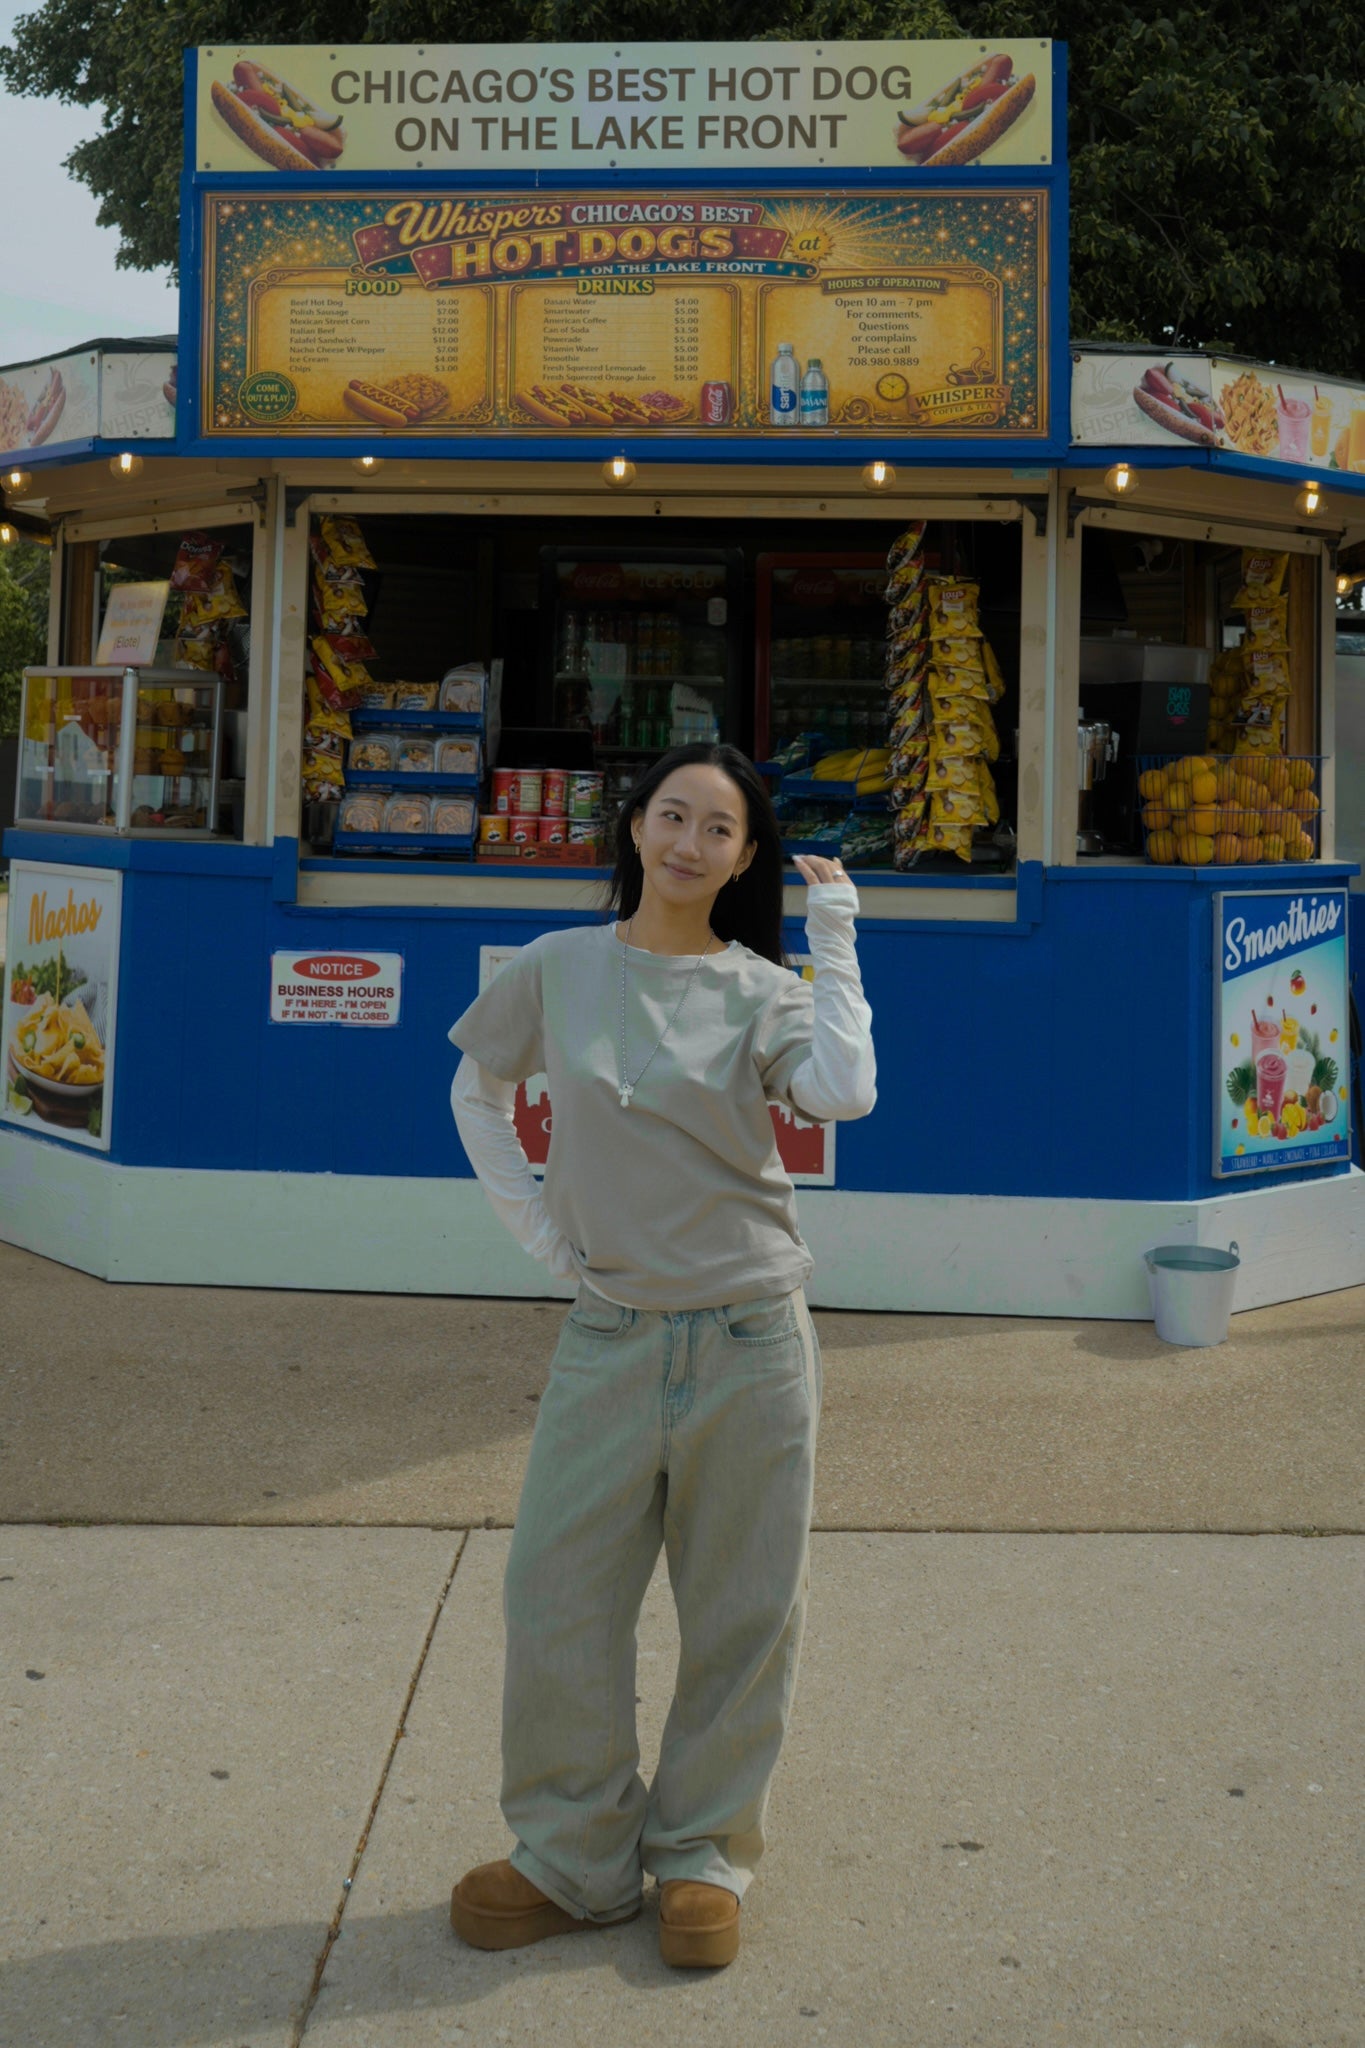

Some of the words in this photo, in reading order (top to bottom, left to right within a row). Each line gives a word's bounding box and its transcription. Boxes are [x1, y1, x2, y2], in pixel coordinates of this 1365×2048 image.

[331, 67, 575, 104] CHICAGO'S
[588, 68, 695, 102] BEST
[708, 67, 800, 101] HOT
[813, 66, 911, 100] DOG
[395, 117, 459, 152] ON
[472, 116, 557, 151] THE
[571, 116, 684, 150] LAKE
[698, 114, 847, 149] FRONT
[571, 204, 694, 224] CHICAGO'S
[700, 206, 753, 224] BEST
[383, 200, 562, 246] Whispers
[799, 236, 820, 251] at
[450, 231, 567, 280] HOT
[578, 227, 734, 263] DOGS
[591, 265, 614, 276] ON
[617, 264, 650, 275] THE
[655, 262, 701, 274] LAKE
[706, 262, 767, 273] FRONT
[346, 279, 401, 296] FOOD
[577, 279, 655, 295] DRINKS
[827, 278, 864, 290] HOURS
[866, 277, 881, 288] OF
[882, 277, 941, 289] OPERATION
[327, 299, 344, 308] Dog
[674, 298, 699, 306] $4.00
[835, 298, 863, 308] Open
[866, 298, 878, 306] 10
[907, 298, 913, 306] 7
[916, 300, 933, 308] pm
[316, 309, 349, 317] Sausage
[437, 308, 459, 316] $7.00
[846, 310, 864, 319] For
[674, 317, 699, 325] $5.00
[432, 327, 459, 335] $12.00
[858, 322, 910, 331] Questions
[674, 336, 699, 344] $5.00
[865, 334, 917, 343] complains
[673, 345, 699, 353] $5.00
[857, 346, 890, 354] Please
[892, 346, 911, 354] call
[434, 355, 458, 363] $4.00
[848, 357, 920, 366] 708.980.9889
[289, 365, 311, 373] Chips
[542, 364, 564, 372] Fresh
[566, 364, 603, 373] Squeezed
[605, 364, 647, 372] Lemonade
[566, 374, 603, 382] Squeezed
[605, 374, 634, 382] Orange
[256, 384, 280, 392] COME
[248, 394, 262, 402] OUT
[263, 394, 270, 402] &
[271, 394, 289, 402] PLAY
[914, 387, 1006, 408] WHISPERS
[933, 407, 964, 416] COFFEE
[975, 403, 992, 412] TEA
[640, 575, 666, 588] ICE
[672, 575, 714, 588] COLD
[28, 887, 102, 945] Nachos
[1225, 897, 1341, 970] Smoothies
[310, 963, 363, 975] NOTICE
[278, 985, 343, 997] BUSINESS
[348, 987, 394, 998] HOURS
[285, 999, 294, 1007] IF
[296, 999, 308, 1007] I'M
[311, 1000, 337, 1008] HERE
[360, 1001, 387, 1009] OPEN
[282, 1010, 290, 1018] IF
[292, 1010, 305, 1018] I'M
[308, 1011, 328, 1019] NOT
[335, 1011, 348, 1019] I'M
[350, 1012, 389, 1021] CLOSED
